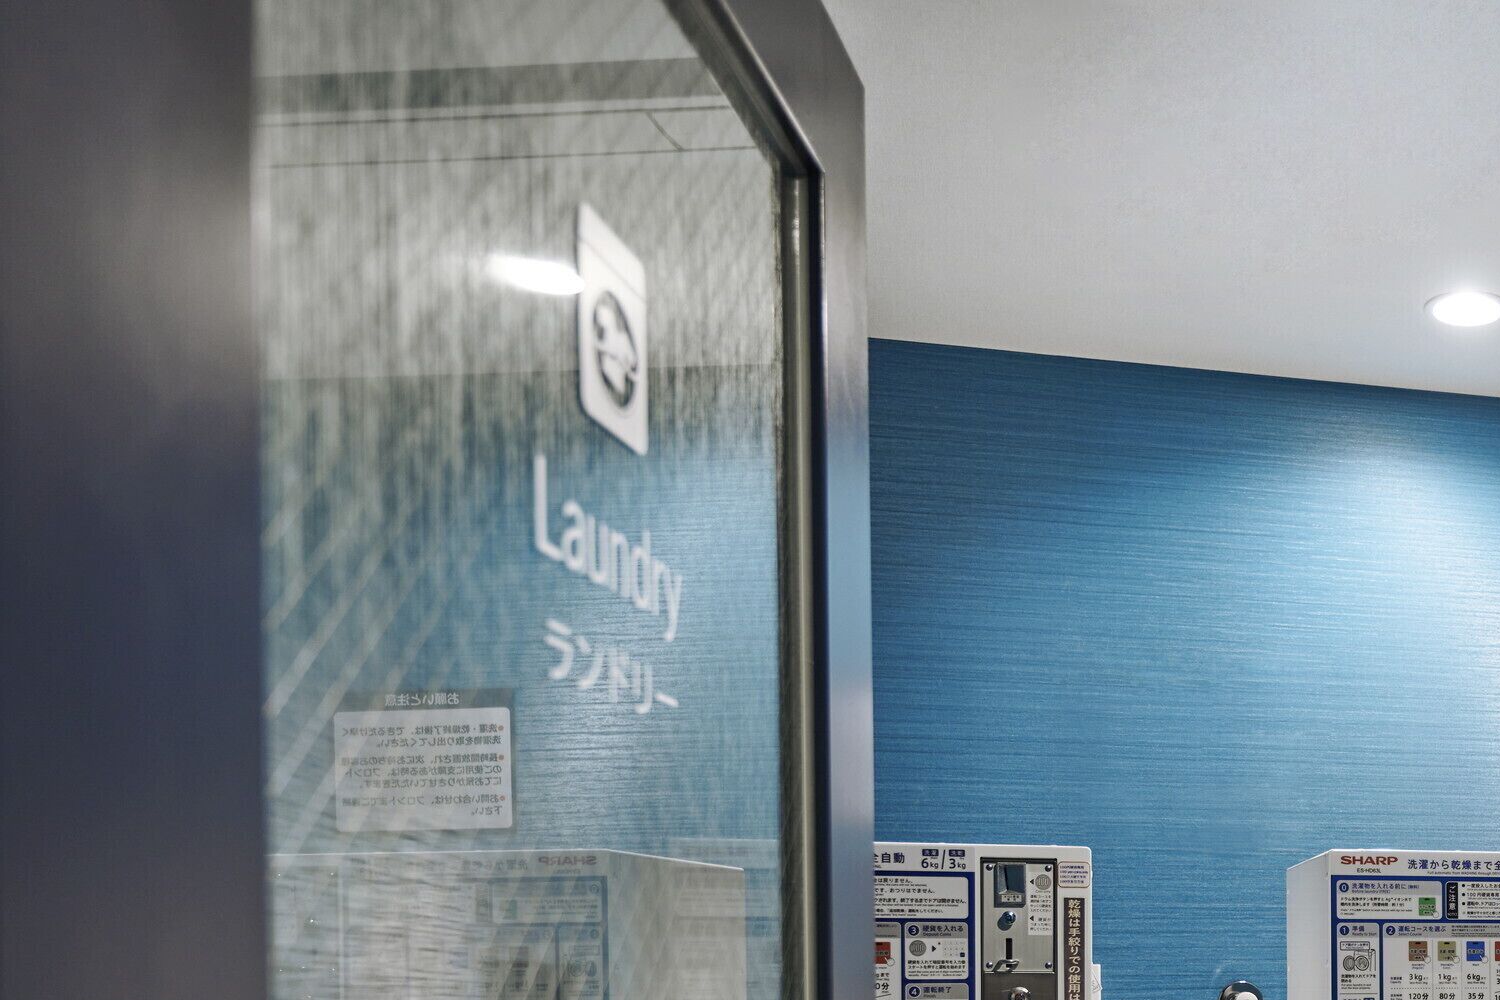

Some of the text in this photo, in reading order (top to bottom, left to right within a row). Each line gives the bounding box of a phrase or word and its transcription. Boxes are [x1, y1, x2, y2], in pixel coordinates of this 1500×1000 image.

[534, 453, 683, 642] Laundry
[544, 617, 679, 714] ランドリー
[1340, 855, 1399, 865] SHARP
[1398, 925, 1447, 933] 運転コースを選ぶ
[1408, 992, 1429, 1000] 120分
[1439, 992, 1456, 1000] 80分
[1468, 992, 1485, 1000] 35分
